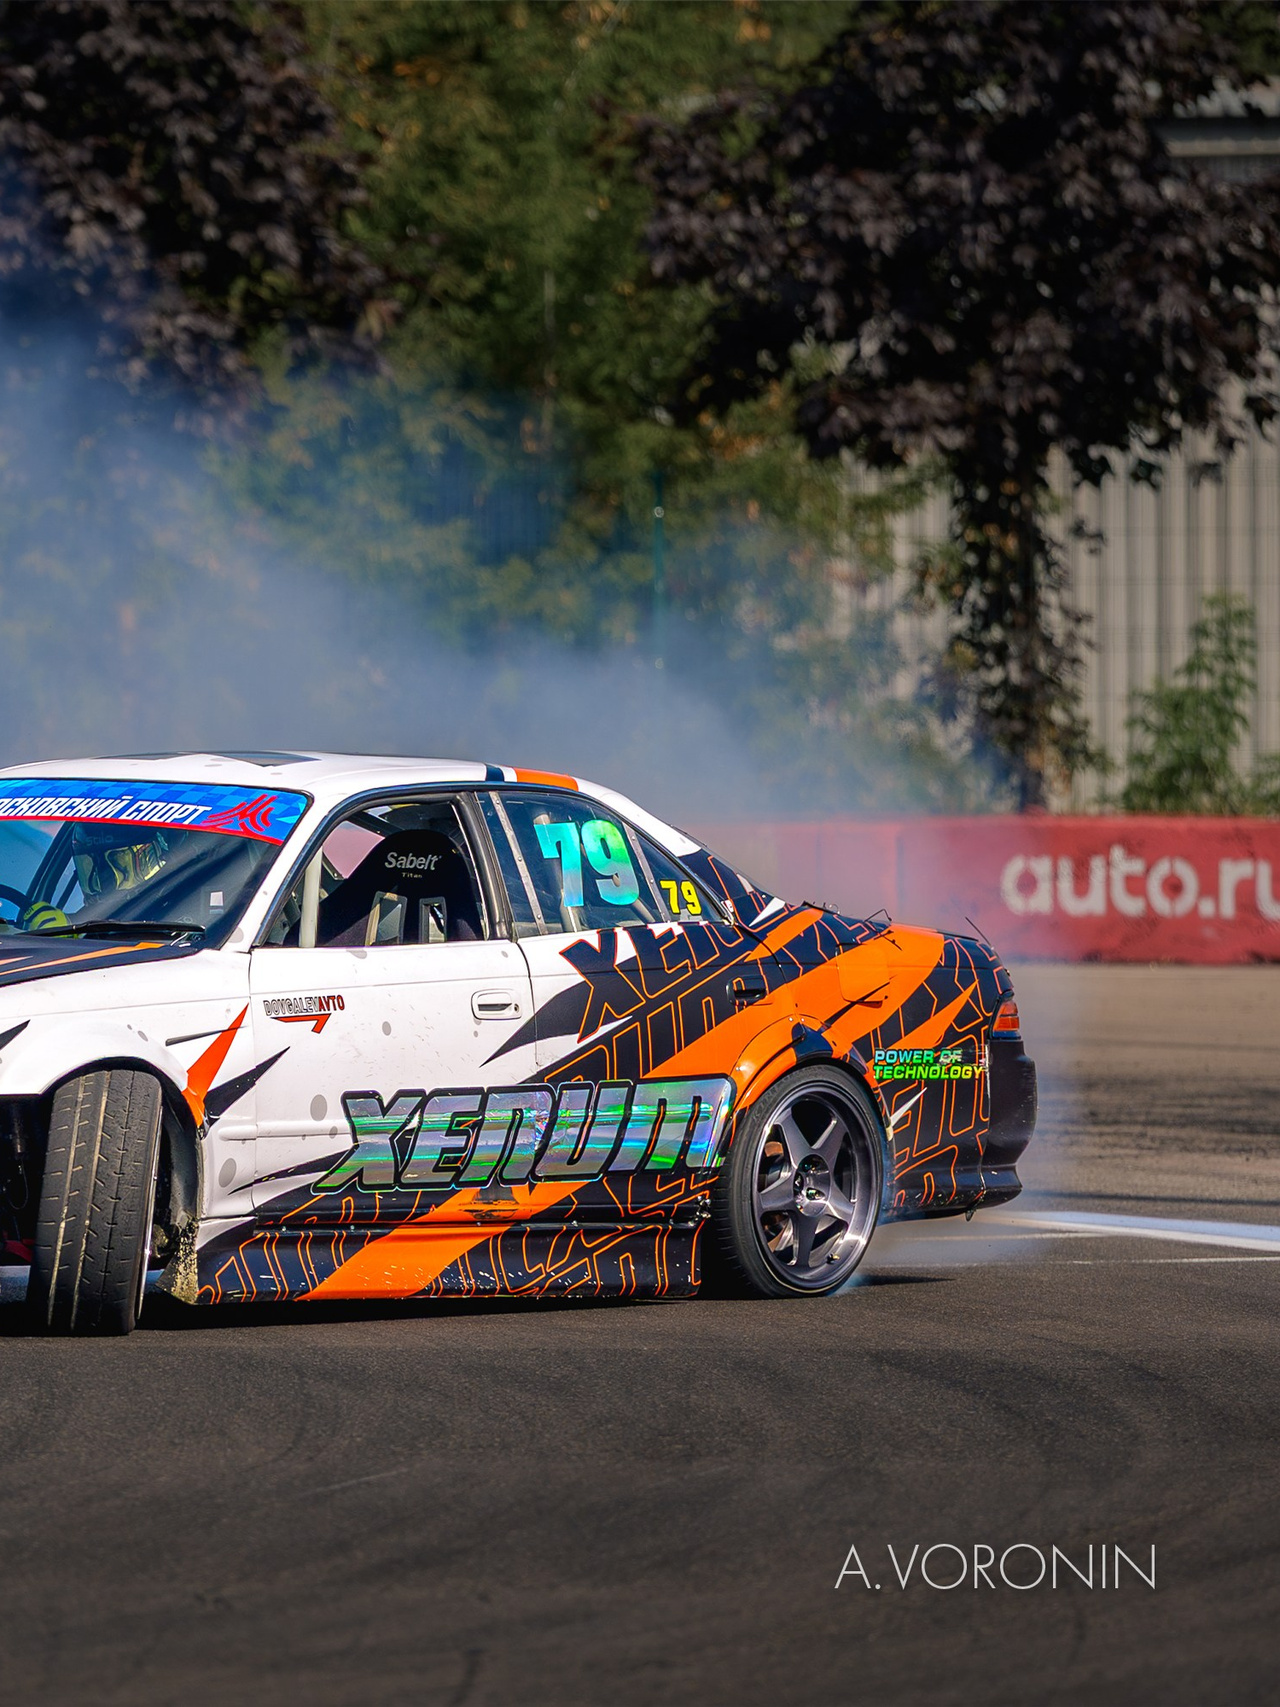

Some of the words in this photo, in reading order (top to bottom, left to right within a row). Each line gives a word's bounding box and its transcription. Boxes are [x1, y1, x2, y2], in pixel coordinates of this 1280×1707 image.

[118, 801, 213, 825] СПОРТ
[384, 852, 439, 870] Sabelt
[533, 819, 640, 907] 79
[660, 880, 703, 915] 79
[263, 994, 345, 1016] DOVGALEVAVTO
[874, 1049, 934, 1064] POWER
[873, 1066, 983, 1079] TECHNOLOGY
[312, 1076, 736, 1194] XENUM
